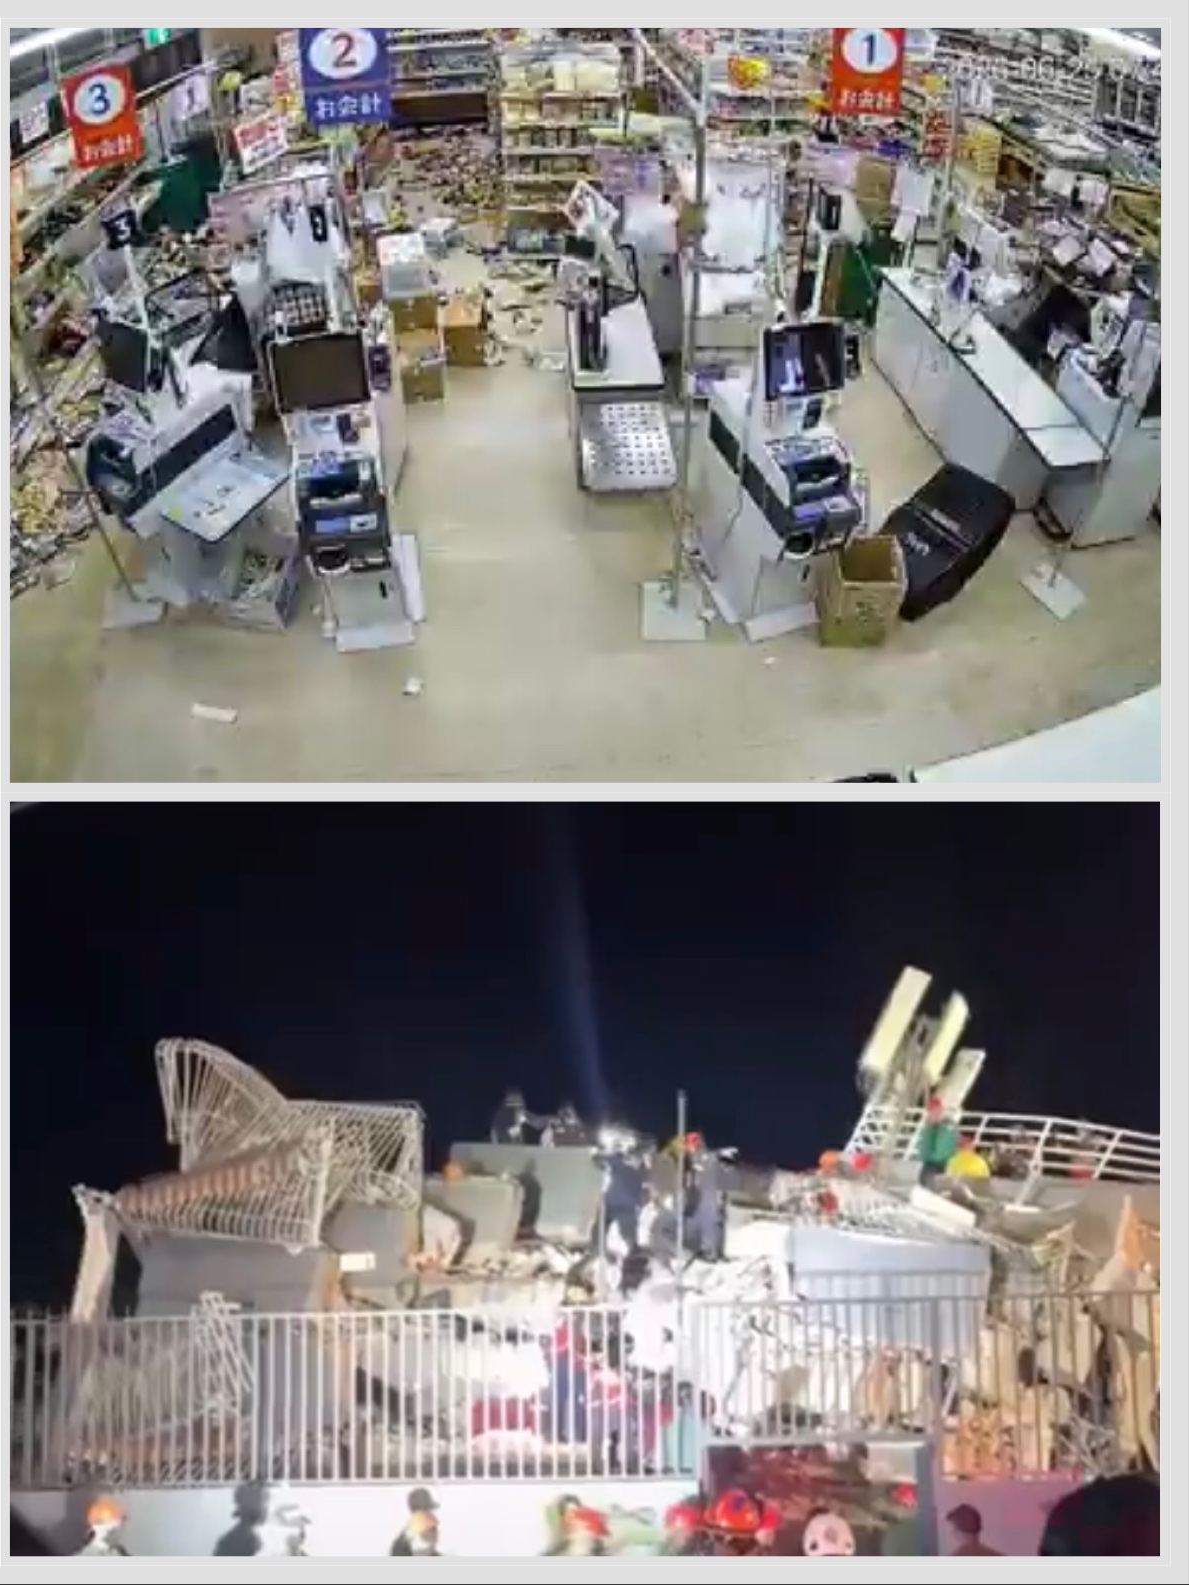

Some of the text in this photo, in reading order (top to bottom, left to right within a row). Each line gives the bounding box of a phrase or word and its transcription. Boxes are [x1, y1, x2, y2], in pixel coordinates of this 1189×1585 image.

[331, 33, 358, 68] 2
[862, 33, 877, 66] 1
[88, 83, 111, 115] 3
[315, 92, 382, 119] お会計
[840, 88, 894, 109] お会計
[82, 133, 134, 161] お会計
[115, 217, 131, 241] 3
